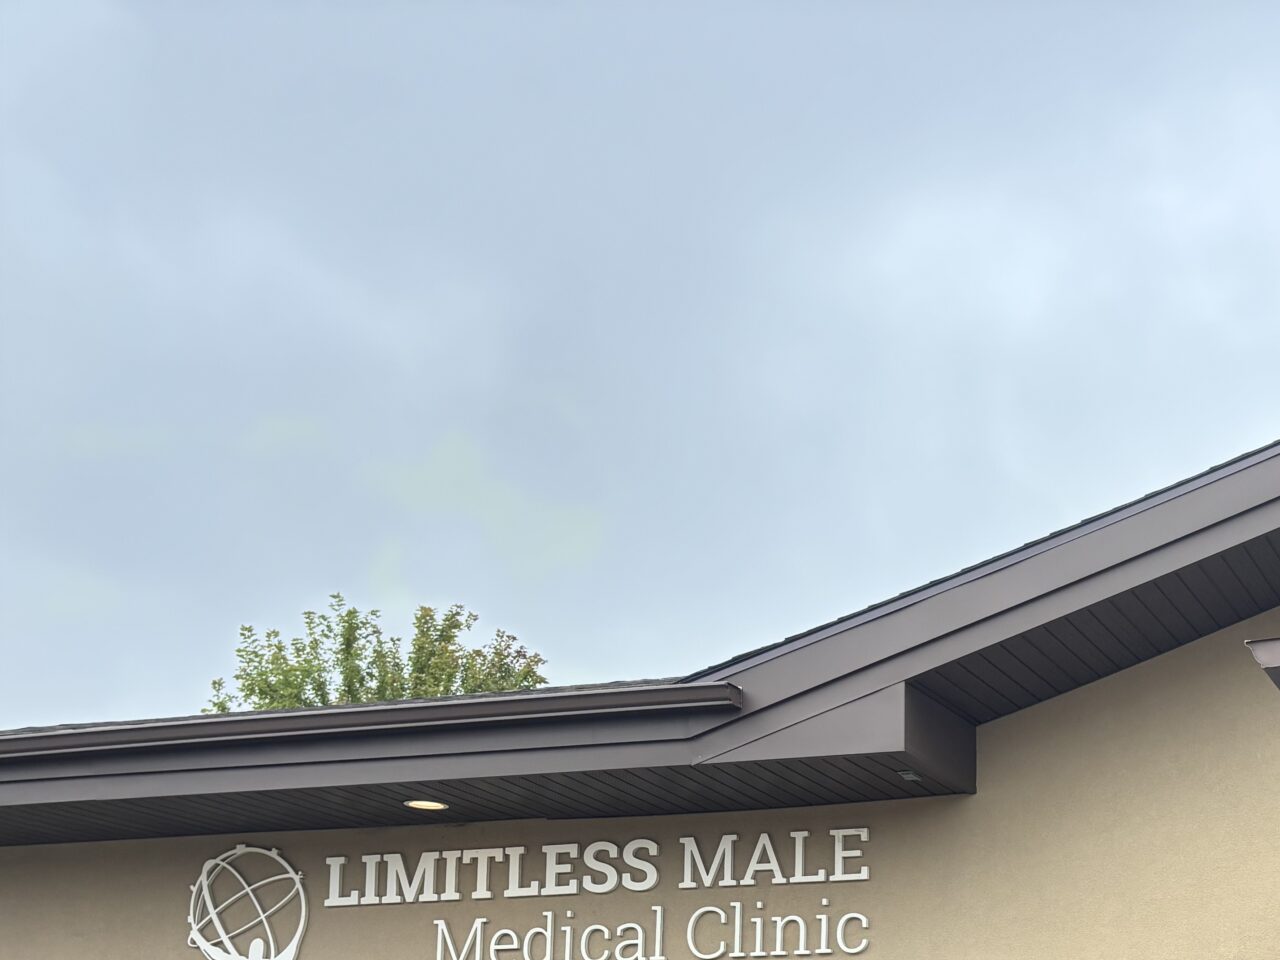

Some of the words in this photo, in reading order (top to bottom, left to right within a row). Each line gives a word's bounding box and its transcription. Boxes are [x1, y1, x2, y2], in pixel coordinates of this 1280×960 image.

[324, 838, 660, 907] LIMITLESS
[678, 827, 870, 889] MALE
[686, 898, 870, 960] Clinic
